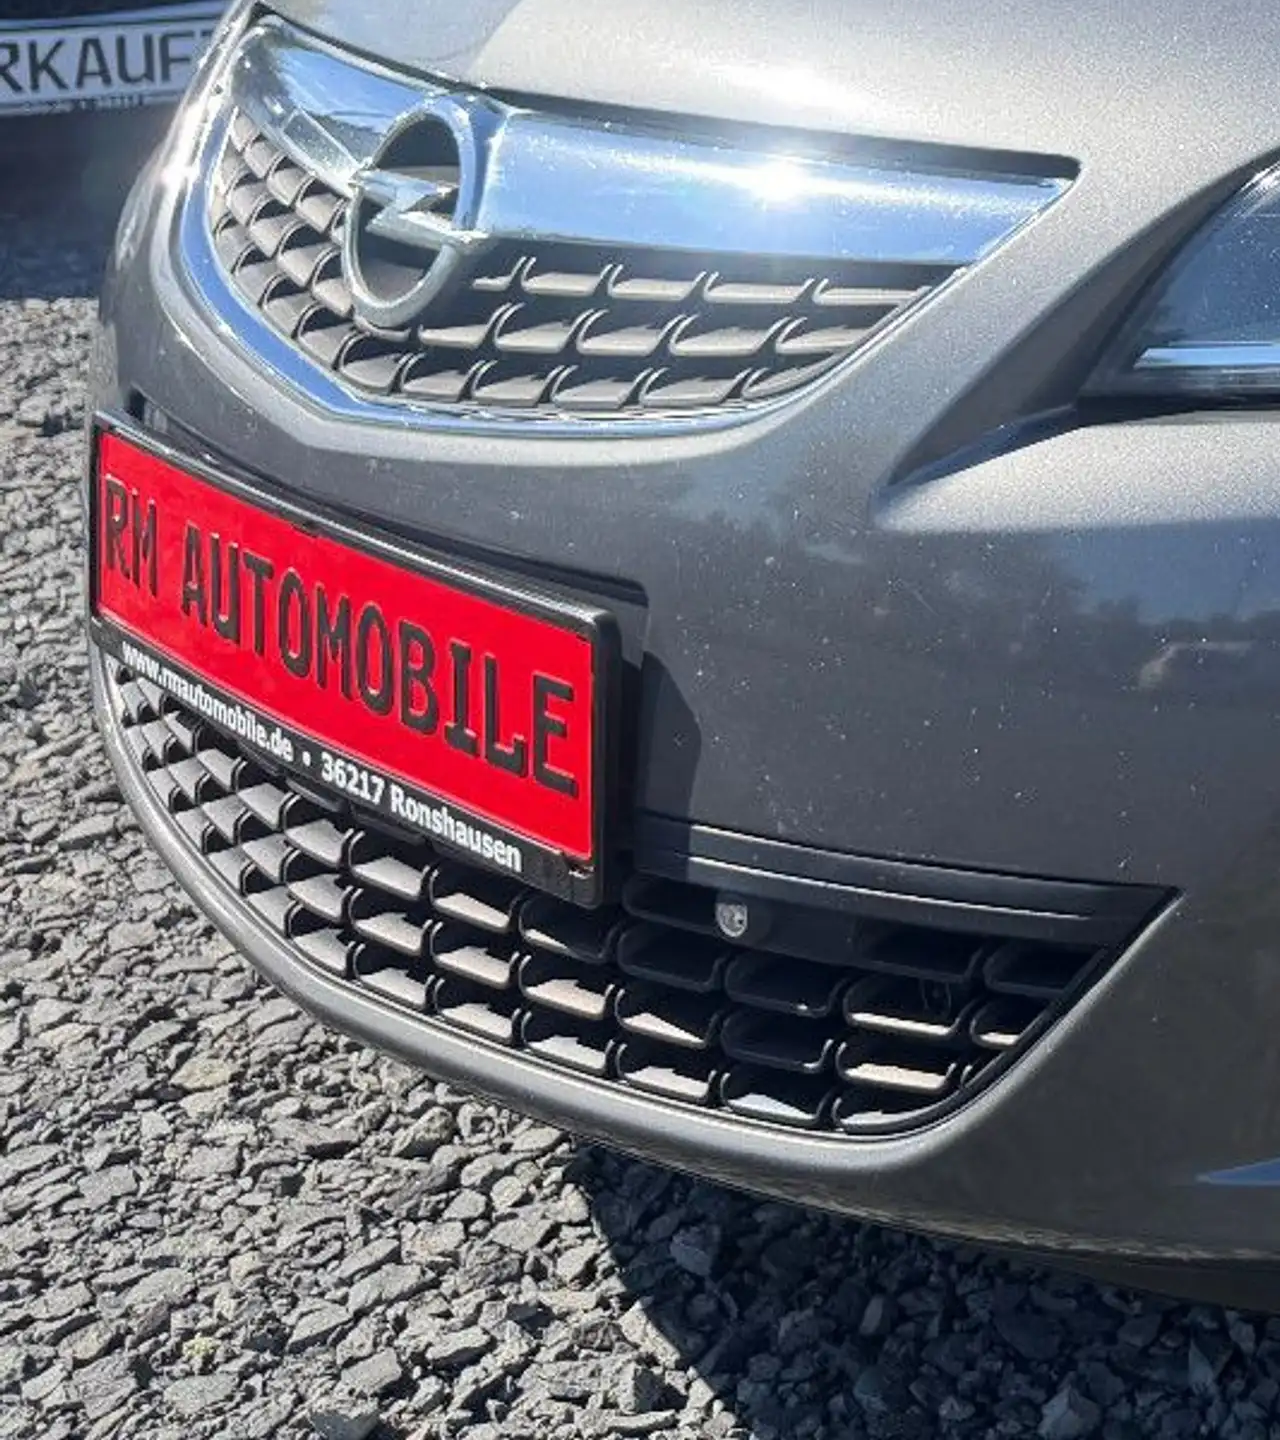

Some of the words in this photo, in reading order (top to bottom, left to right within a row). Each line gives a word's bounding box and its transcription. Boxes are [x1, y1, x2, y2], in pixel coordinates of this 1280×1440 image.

[103, 472, 158, 598] RM
[180, 518, 580, 799] AUTOMOBILE
[121, 640, 295, 763] www.rmautomobile.de
[321, 750, 386, 806] 36217
[390, 783, 523, 873] Ronshausen
